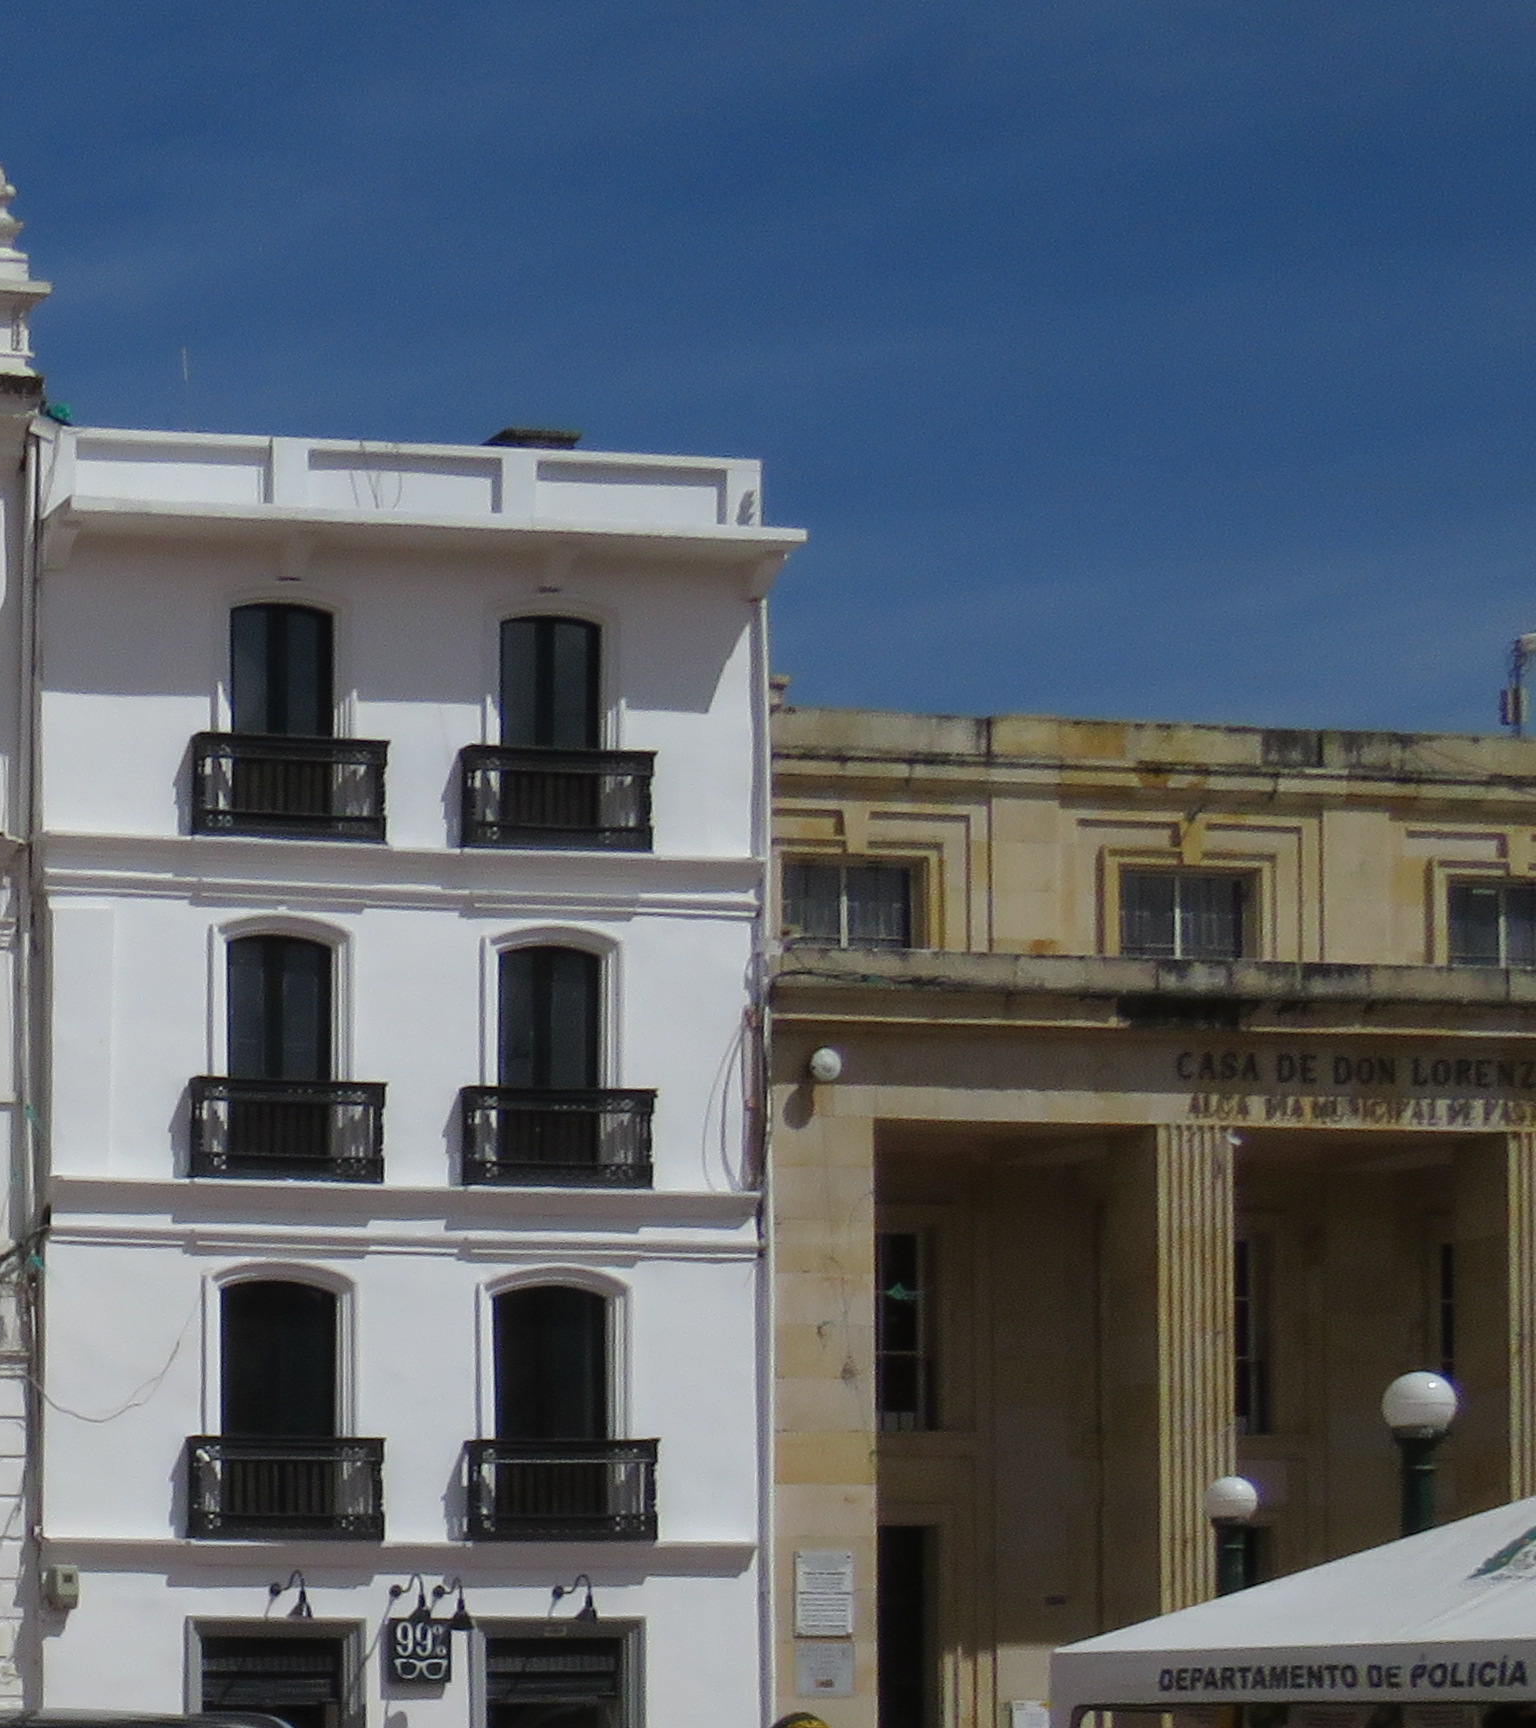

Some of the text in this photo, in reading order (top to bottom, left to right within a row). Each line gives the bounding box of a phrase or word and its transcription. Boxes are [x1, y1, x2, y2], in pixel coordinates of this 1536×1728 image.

[1177, 1051, 1262, 1082] CASA
[1276, 1053, 1319, 1084] DE
[1333, 1055, 1397, 1087] DON
[395, 1621, 448, 1657] 99%
[1158, 1654, 1528, 1692] DEPARTAMENTO DE POLICÍA
